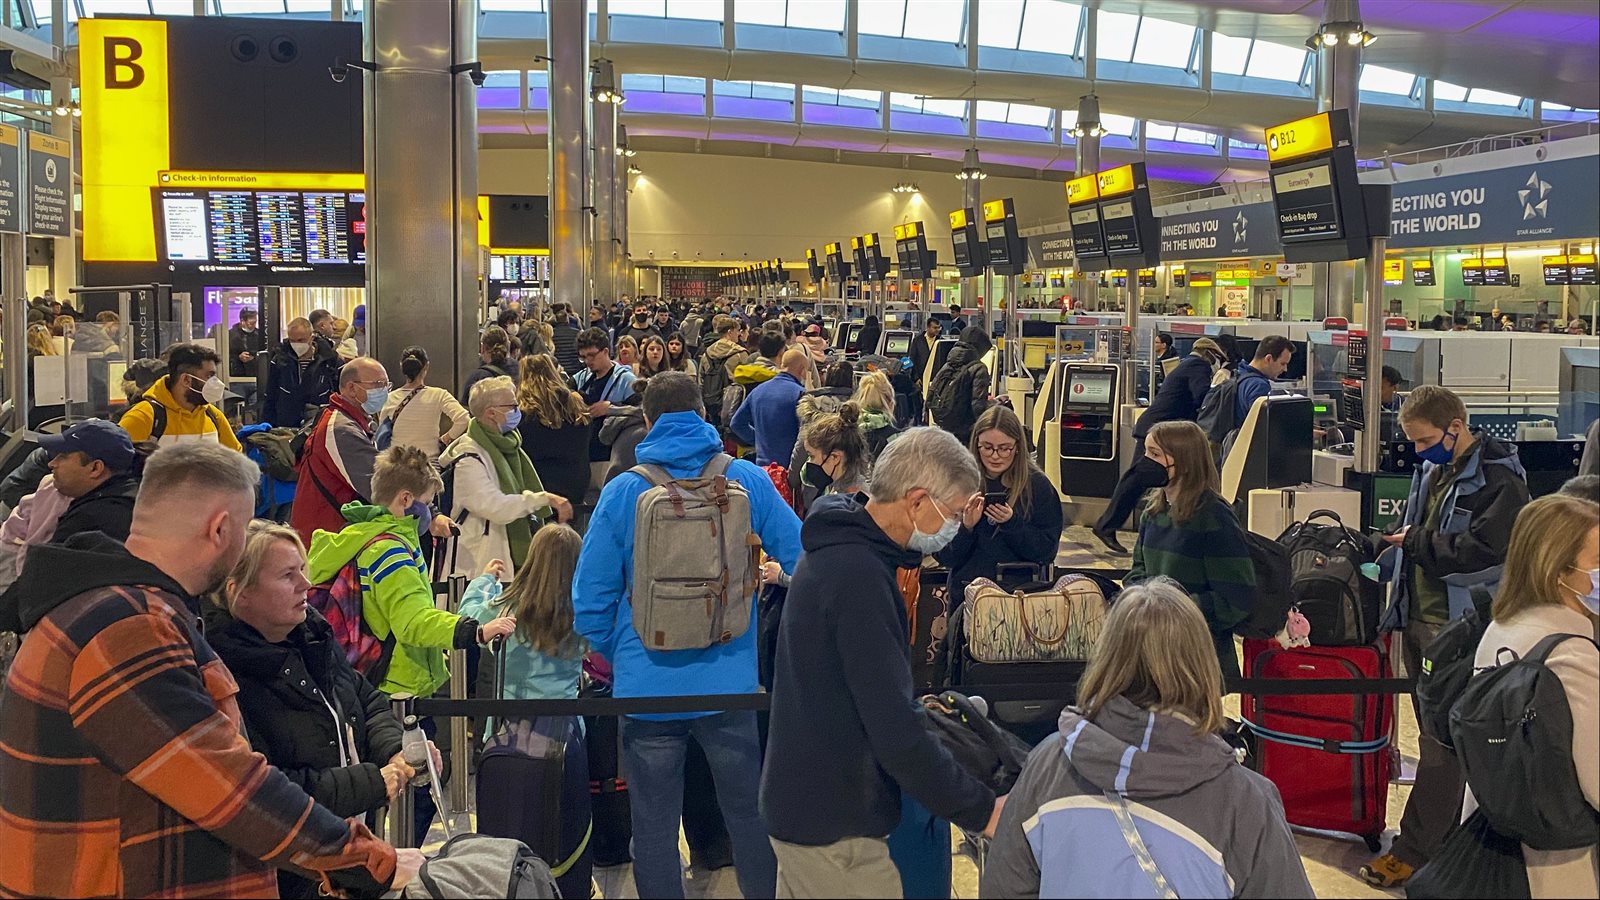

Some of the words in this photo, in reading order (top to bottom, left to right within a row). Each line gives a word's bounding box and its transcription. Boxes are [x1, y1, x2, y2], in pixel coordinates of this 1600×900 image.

[102, 36, 145, 90] B
[1280, 130, 1296, 145] B12
[42, 138, 55, 149] Zone
[172, 174, 207, 182] Check-in
[208, 175, 257, 183] information
[1105, 175, 1114, 186] B11
[1288, 178, 1310, 188] Eurowings
[34, 184, 47, 194] Please
[47, 186, 57, 195] check
[34, 193, 45, 204] Flight
[1392, 192, 1446, 213] ECTING
[1450, 187, 1485, 206] YOU
[34, 203, 48, 213] Display
[49, 205, 62, 213] screens
[41, 213, 50, 222] your
[1280, 213, 1297, 223] Check-in
[1297, 212, 1307, 222] Bag
[1307, 211, 1318, 220] drop
[34, 221, 50, 229] check-in
[1202, 219, 1218, 232] YOU
[1391, 218, 1420, 235] THE
[1423, 212, 1481, 232] WORLD
[1042, 238, 1070, 250] CONNECTING
[1161, 240, 1172, 251] TH
[1173, 239, 1187, 251] THE
[1188, 237, 1216, 250] WORLD
[1043, 252, 1053, 261] WITH
[1053, 251, 1062, 260] THE
[1062, 250, 1073, 260] WOR
[671, 280, 705, 289] WELCOME
[671, 289, 681, 297] TO
[681, 289, 705, 297] COSTA
[1378, 498, 1406, 516] EX
